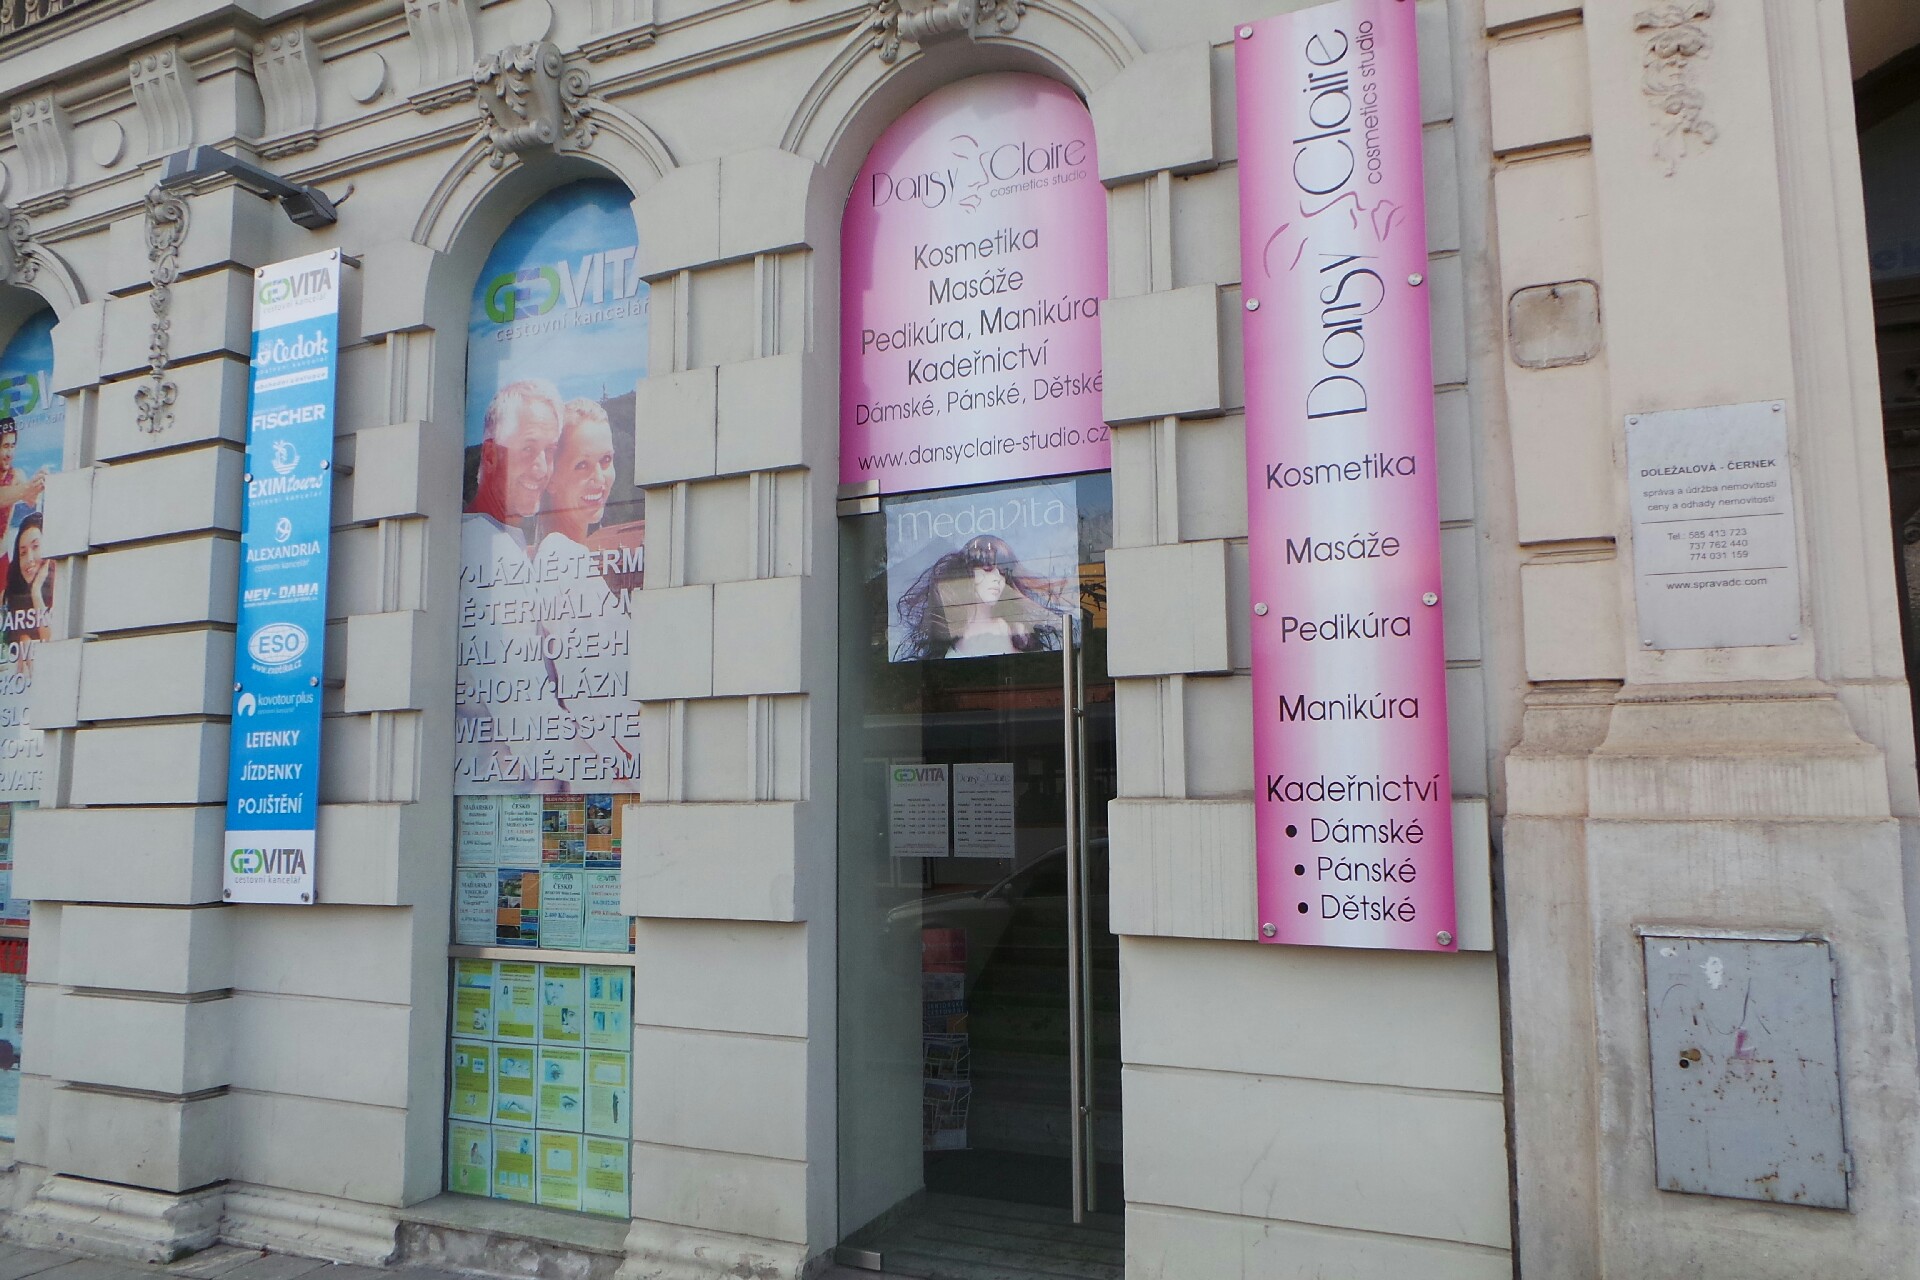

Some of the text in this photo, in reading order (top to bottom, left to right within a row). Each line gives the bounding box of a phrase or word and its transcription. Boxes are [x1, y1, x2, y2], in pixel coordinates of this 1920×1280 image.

[1293, 29, 1354, 195] Claire
[1356, 20, 1382, 184] cosmetics studio
[872, 140, 1086, 209] Dansy Claire
[990, 168, 1087, 198] cosmetics studio
[914, 228, 1039, 270] Kosmetika
[929, 268, 1024, 305] Masáže
[861, 295, 1100, 355] Pedikúra, Manikúra
[1306, 253, 1385, 420] Dansy
[908, 338, 1049, 385] Kadeřnictví
[252, 404, 325, 432] FISCHER
[856, 394, 940, 426] Dámské,
[947, 383, 1027, 413] Pánské,
[858, 426, 1109, 471] www.dansyclaire-studio.cz
[1266, 453, 1416, 489] Kosmetika
[1727, 459, 1776, 471] ČERNEK
[1647, 503, 1669, 511] ceny
[1681, 499, 1716, 509] odhady
[1286, 531, 1400, 565] Masáže
[1688, 531, 1706, 539] 585
[1708, 529, 1726, 538] 413
[1729, 528, 1747, 536] 723
[1689, 542, 1706, 550] 737
[1709, 541, 1727, 549] 762
[246, 541, 320, 563] ALEXANDRIA
[1690, 550, 1749, 561] 774 031 159
[1281, 612, 1411, 643] Pedikúra
[259, 632, 299, 655] ESO
[1279, 692, 1419, 722] Manikúra
[246, 730, 300, 748] LETENKY
[457, 714, 595, 743] WELLNESS
[240, 760, 303, 781] JÍZDENKY
[894, 768, 944, 782] GEOVITA
[1267, 773, 1441, 802] Kadeřnictví
[238, 792, 303, 814] POJIŠTĚNÍ
[1311, 818, 1424, 844] Dámské
[230, 848, 307, 874] GEOVITA
[1317, 856, 1416, 883] Pánské
[1321, 894, 1417, 922] Dětské
